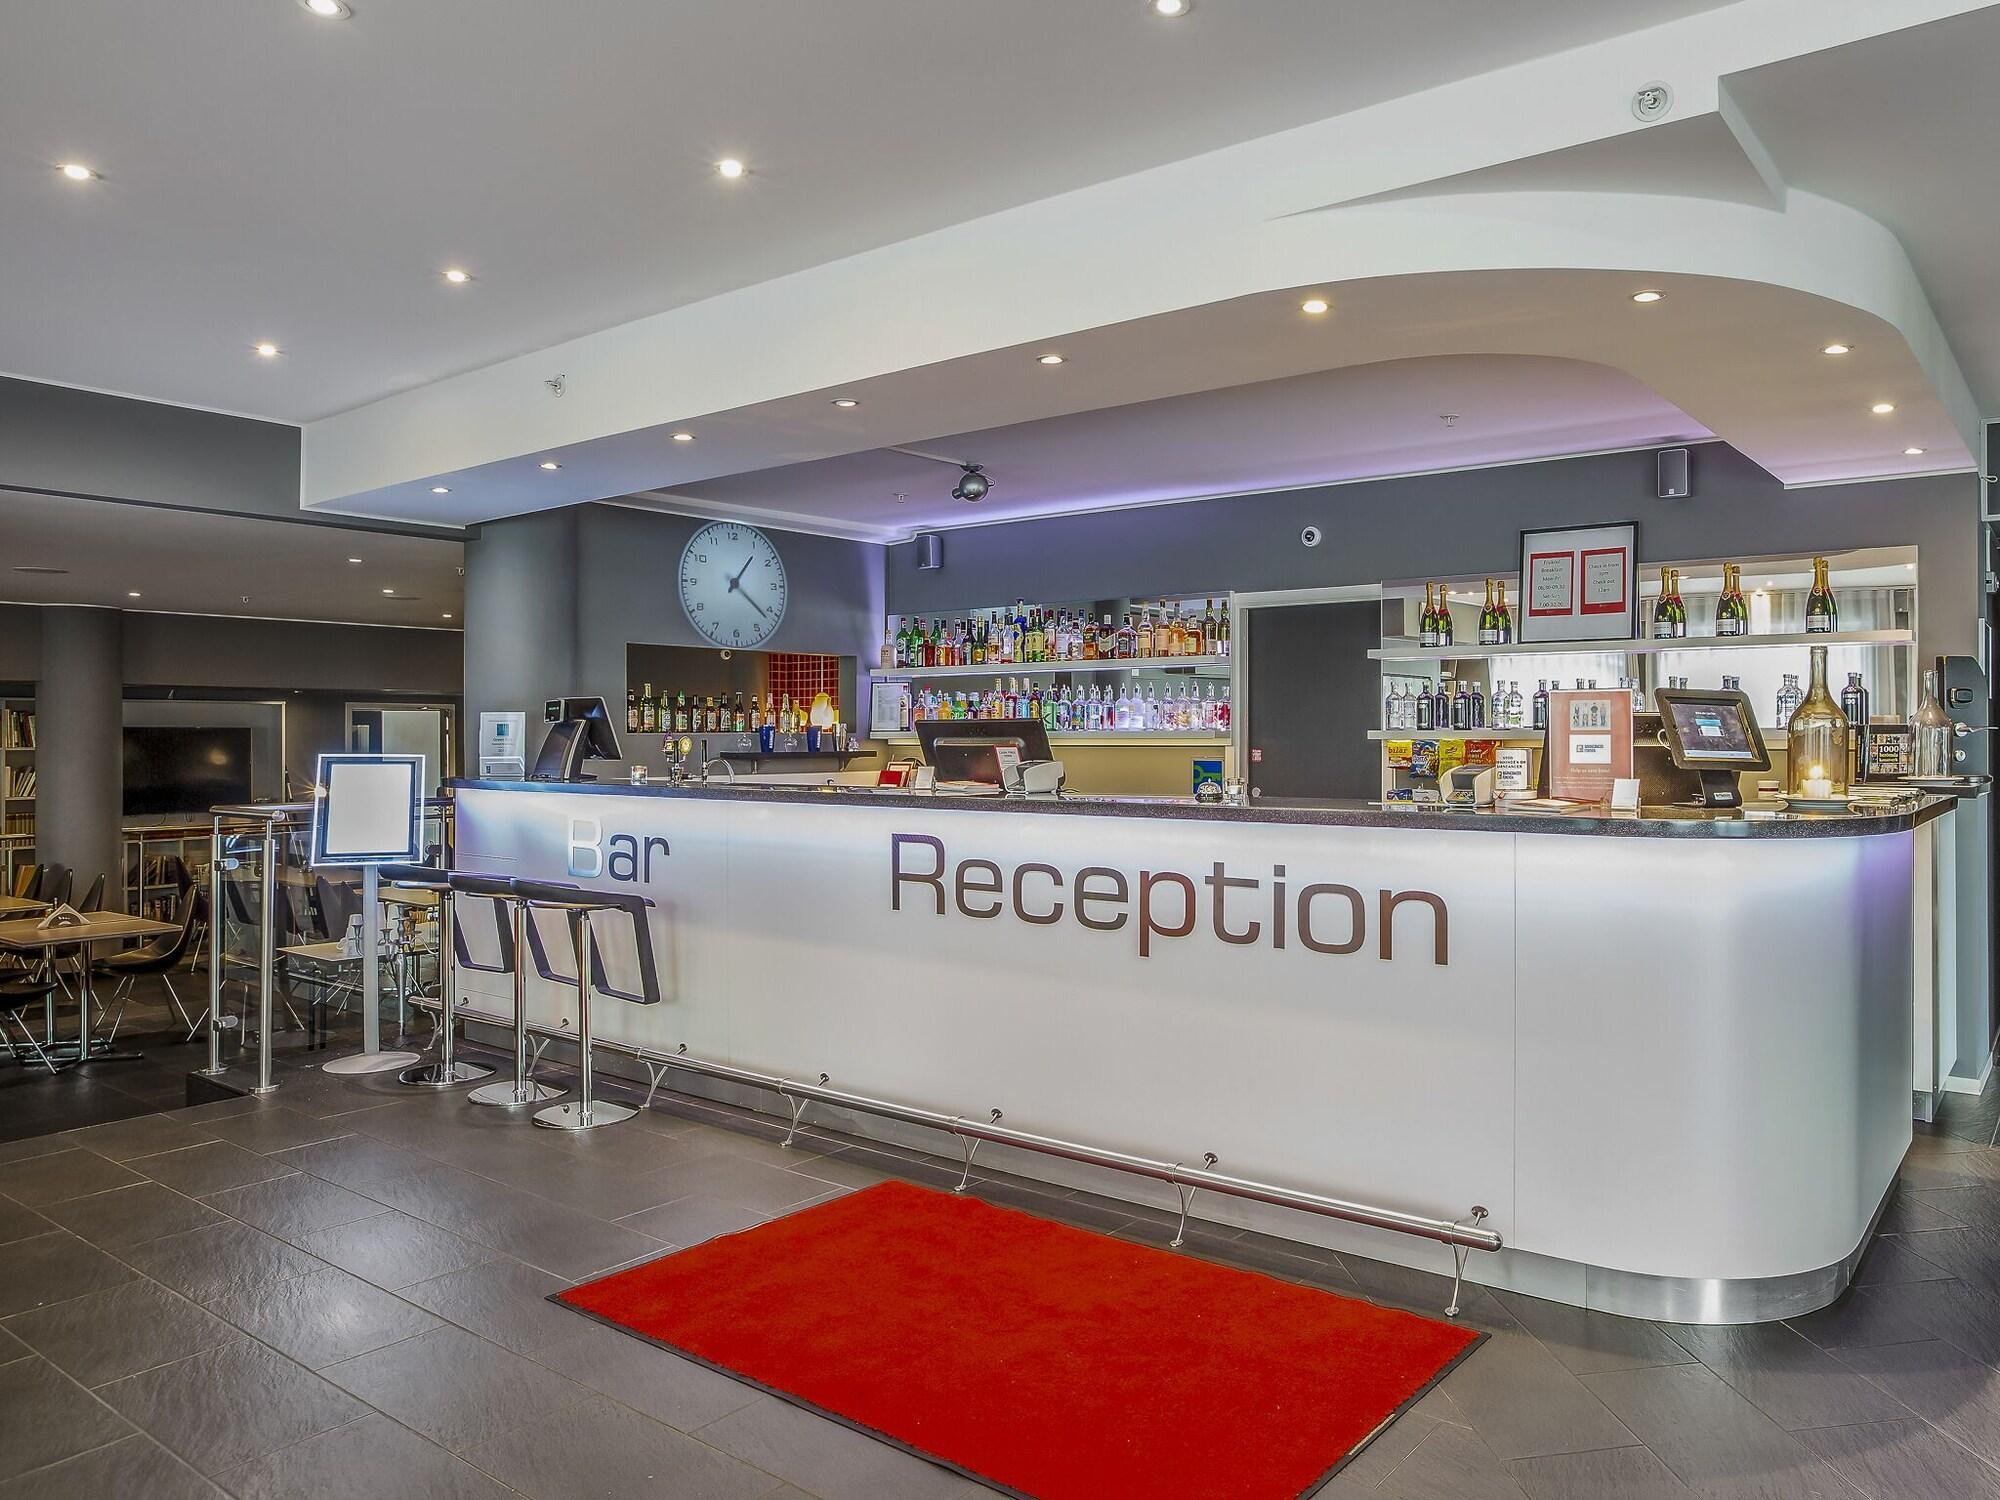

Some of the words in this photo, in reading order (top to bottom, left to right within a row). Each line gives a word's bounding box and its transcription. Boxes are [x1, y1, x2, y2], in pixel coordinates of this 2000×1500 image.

[709, 536, 720, 545] 11
[727, 532, 739, 541] 12
[751, 541, 756, 549] 1
[694, 553, 708, 564] 10
[764, 559, 772, 567] 2
[690, 577, 697, 586] 9
[770, 582, 778, 591] 3
[697, 602, 704, 611] 8
[766, 605, 773, 613] 4
[712, 622, 720, 631] 7
[753, 623, 761, 632] 5
[733, 629, 740, 638] 6
[1879, 745, 1899, 753] 1000
[567, 815, 670, 884] Bar
[890, 832, 1449, 966] Reception
